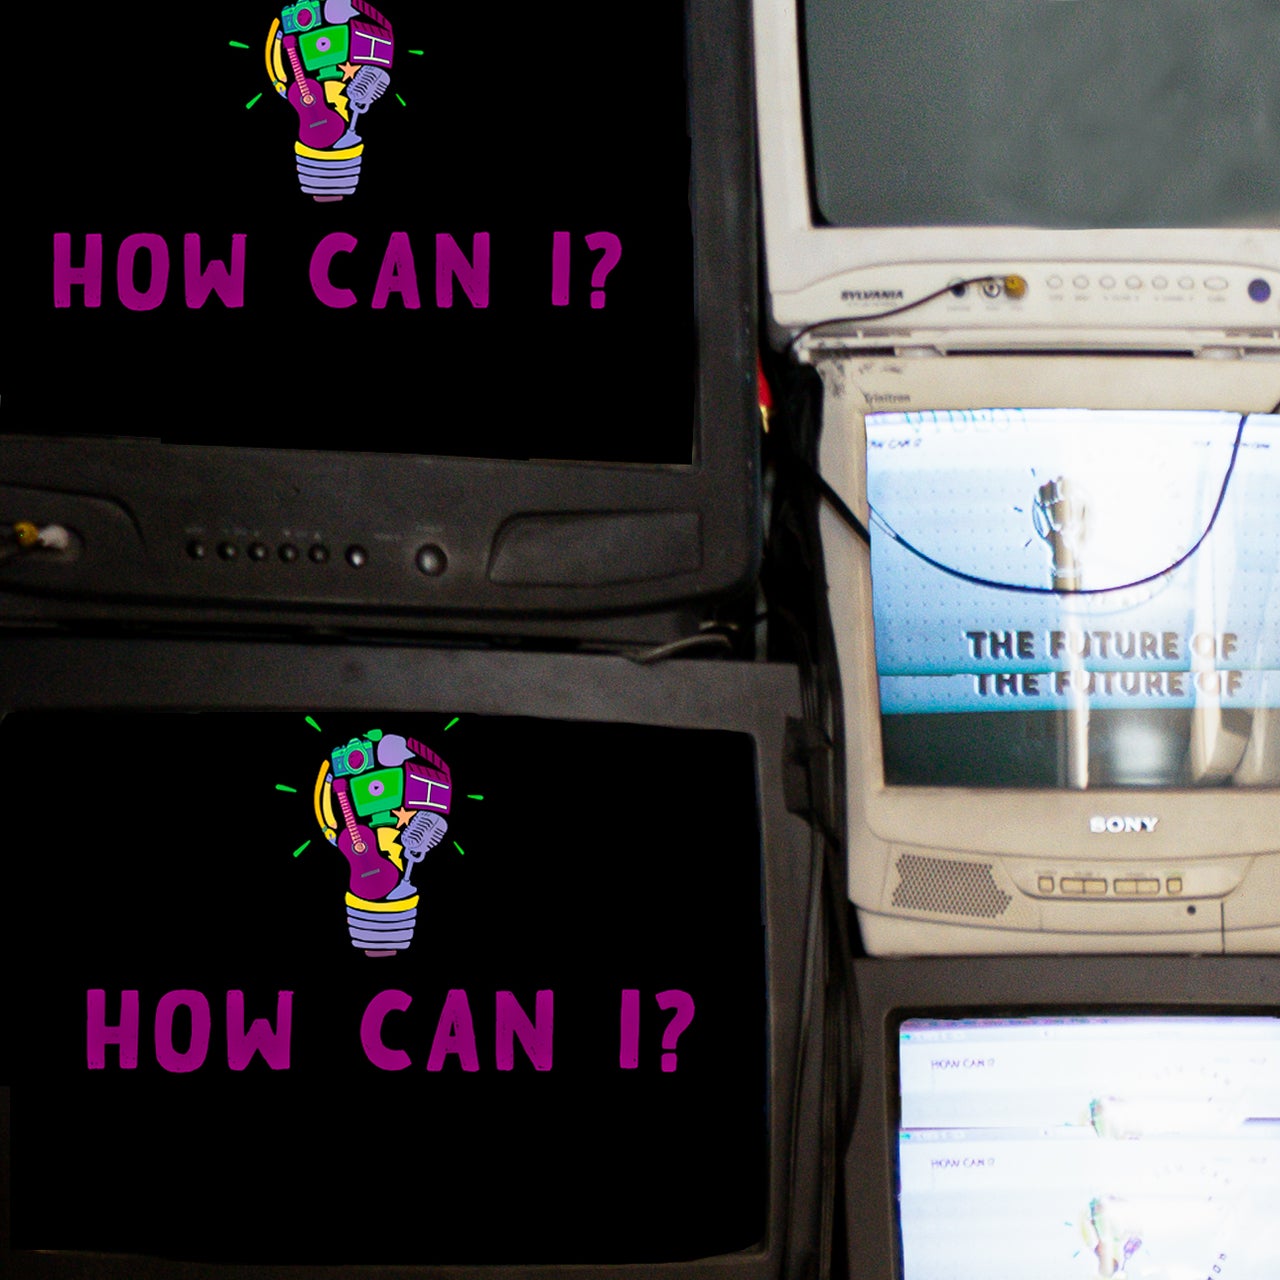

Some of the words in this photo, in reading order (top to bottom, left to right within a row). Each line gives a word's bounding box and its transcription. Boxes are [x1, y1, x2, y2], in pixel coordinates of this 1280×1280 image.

[54, 232, 248, 311] HOW
[310, 231, 490, 310] CAN
[552, 231, 623, 309] I?
[841, 288, 904, 301] SYLVANIA
[964, 629, 1035, 660] THE
[1048, 629, 1181, 660] FUTURE
[1188, 629, 1239, 660] OF
[973, 670, 1040, 697] THE
[1053, 670, 1185, 697] FUTURE
[1089, 815, 1159, 833] SONY
[87, 988, 294, 1073] HOW
[361, 988, 554, 1073] CAN
[620, 988, 696, 1073] I?
